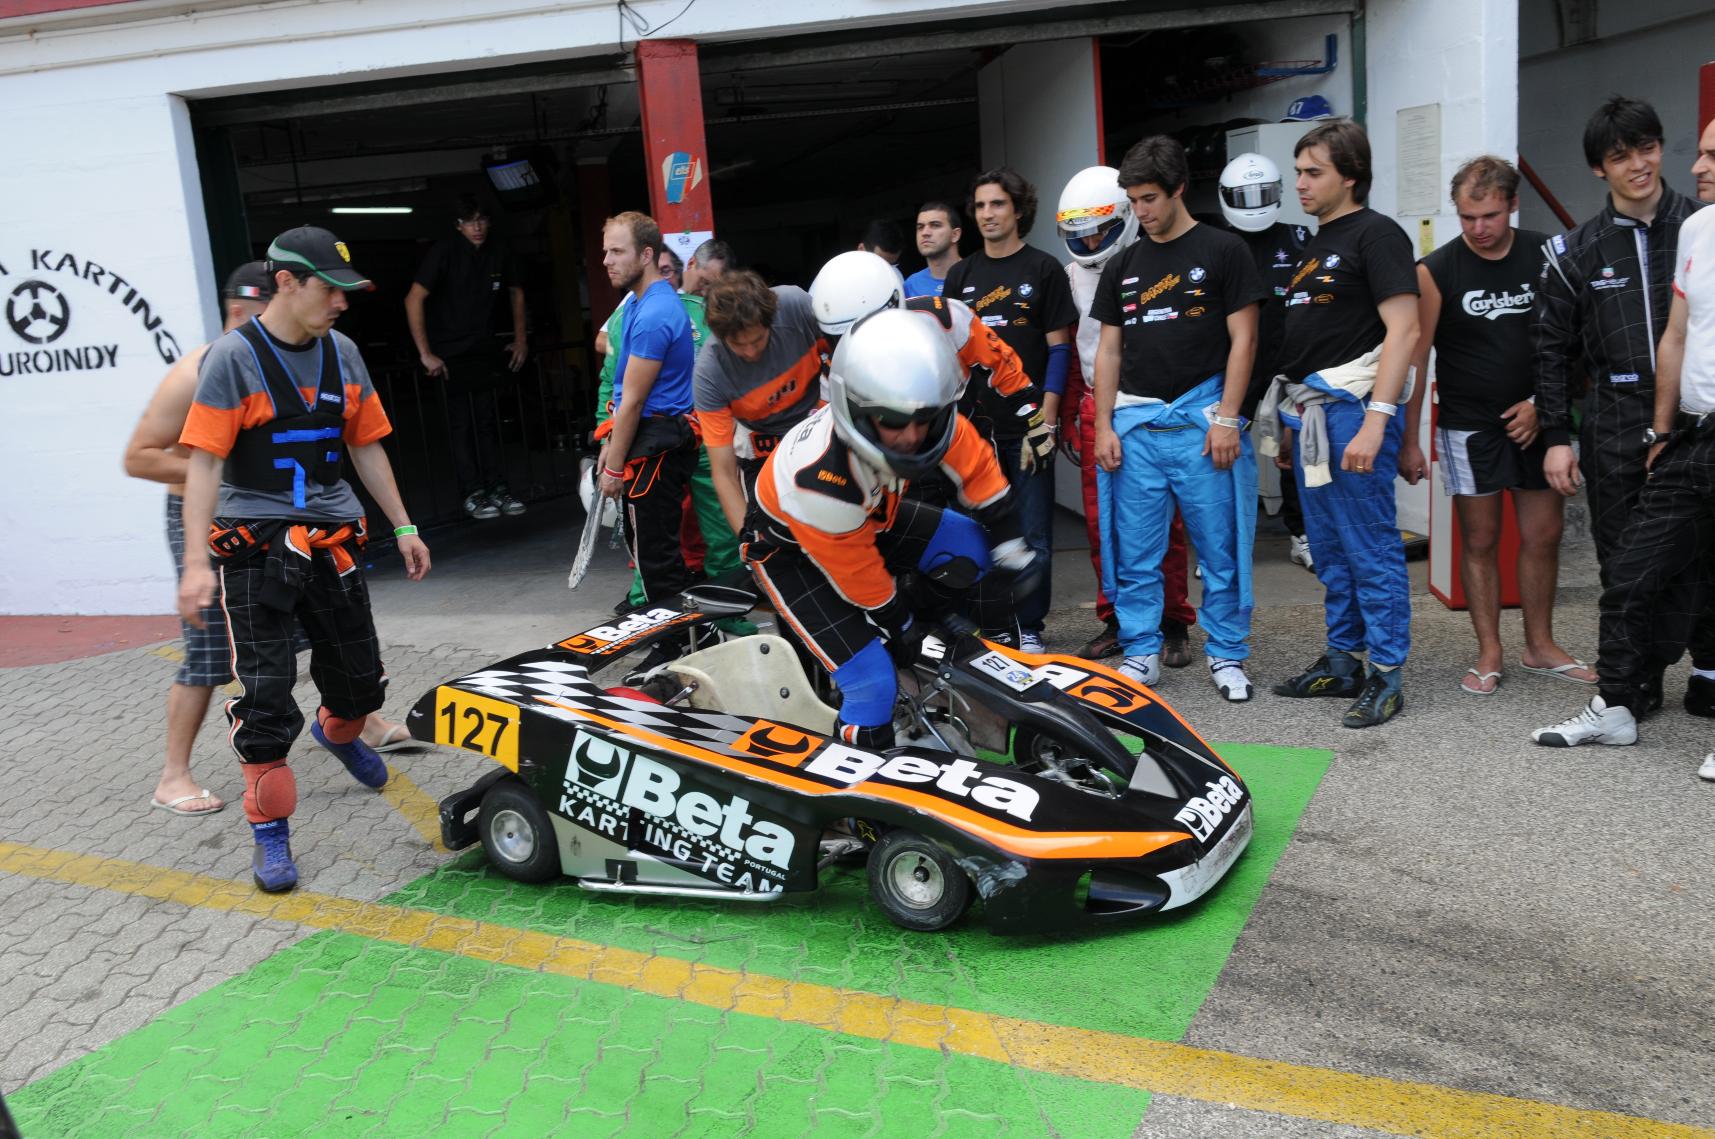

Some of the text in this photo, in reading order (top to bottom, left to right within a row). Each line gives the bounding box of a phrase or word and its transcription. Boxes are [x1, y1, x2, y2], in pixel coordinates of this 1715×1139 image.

[30, 249, 182, 365] KARTING
[583, 608, 683, 642] Beta
[982, 655, 1010, 671] 127
[441, 701, 509, 757] 127
[804, 742, 1040, 822] Beta
[1185, 775, 1244, 829] Beta
[622, 754, 796, 871] Beta
[559, 795, 784, 893] KARTING TEAM
[744, 859, 786, 881] PORTUGAL
